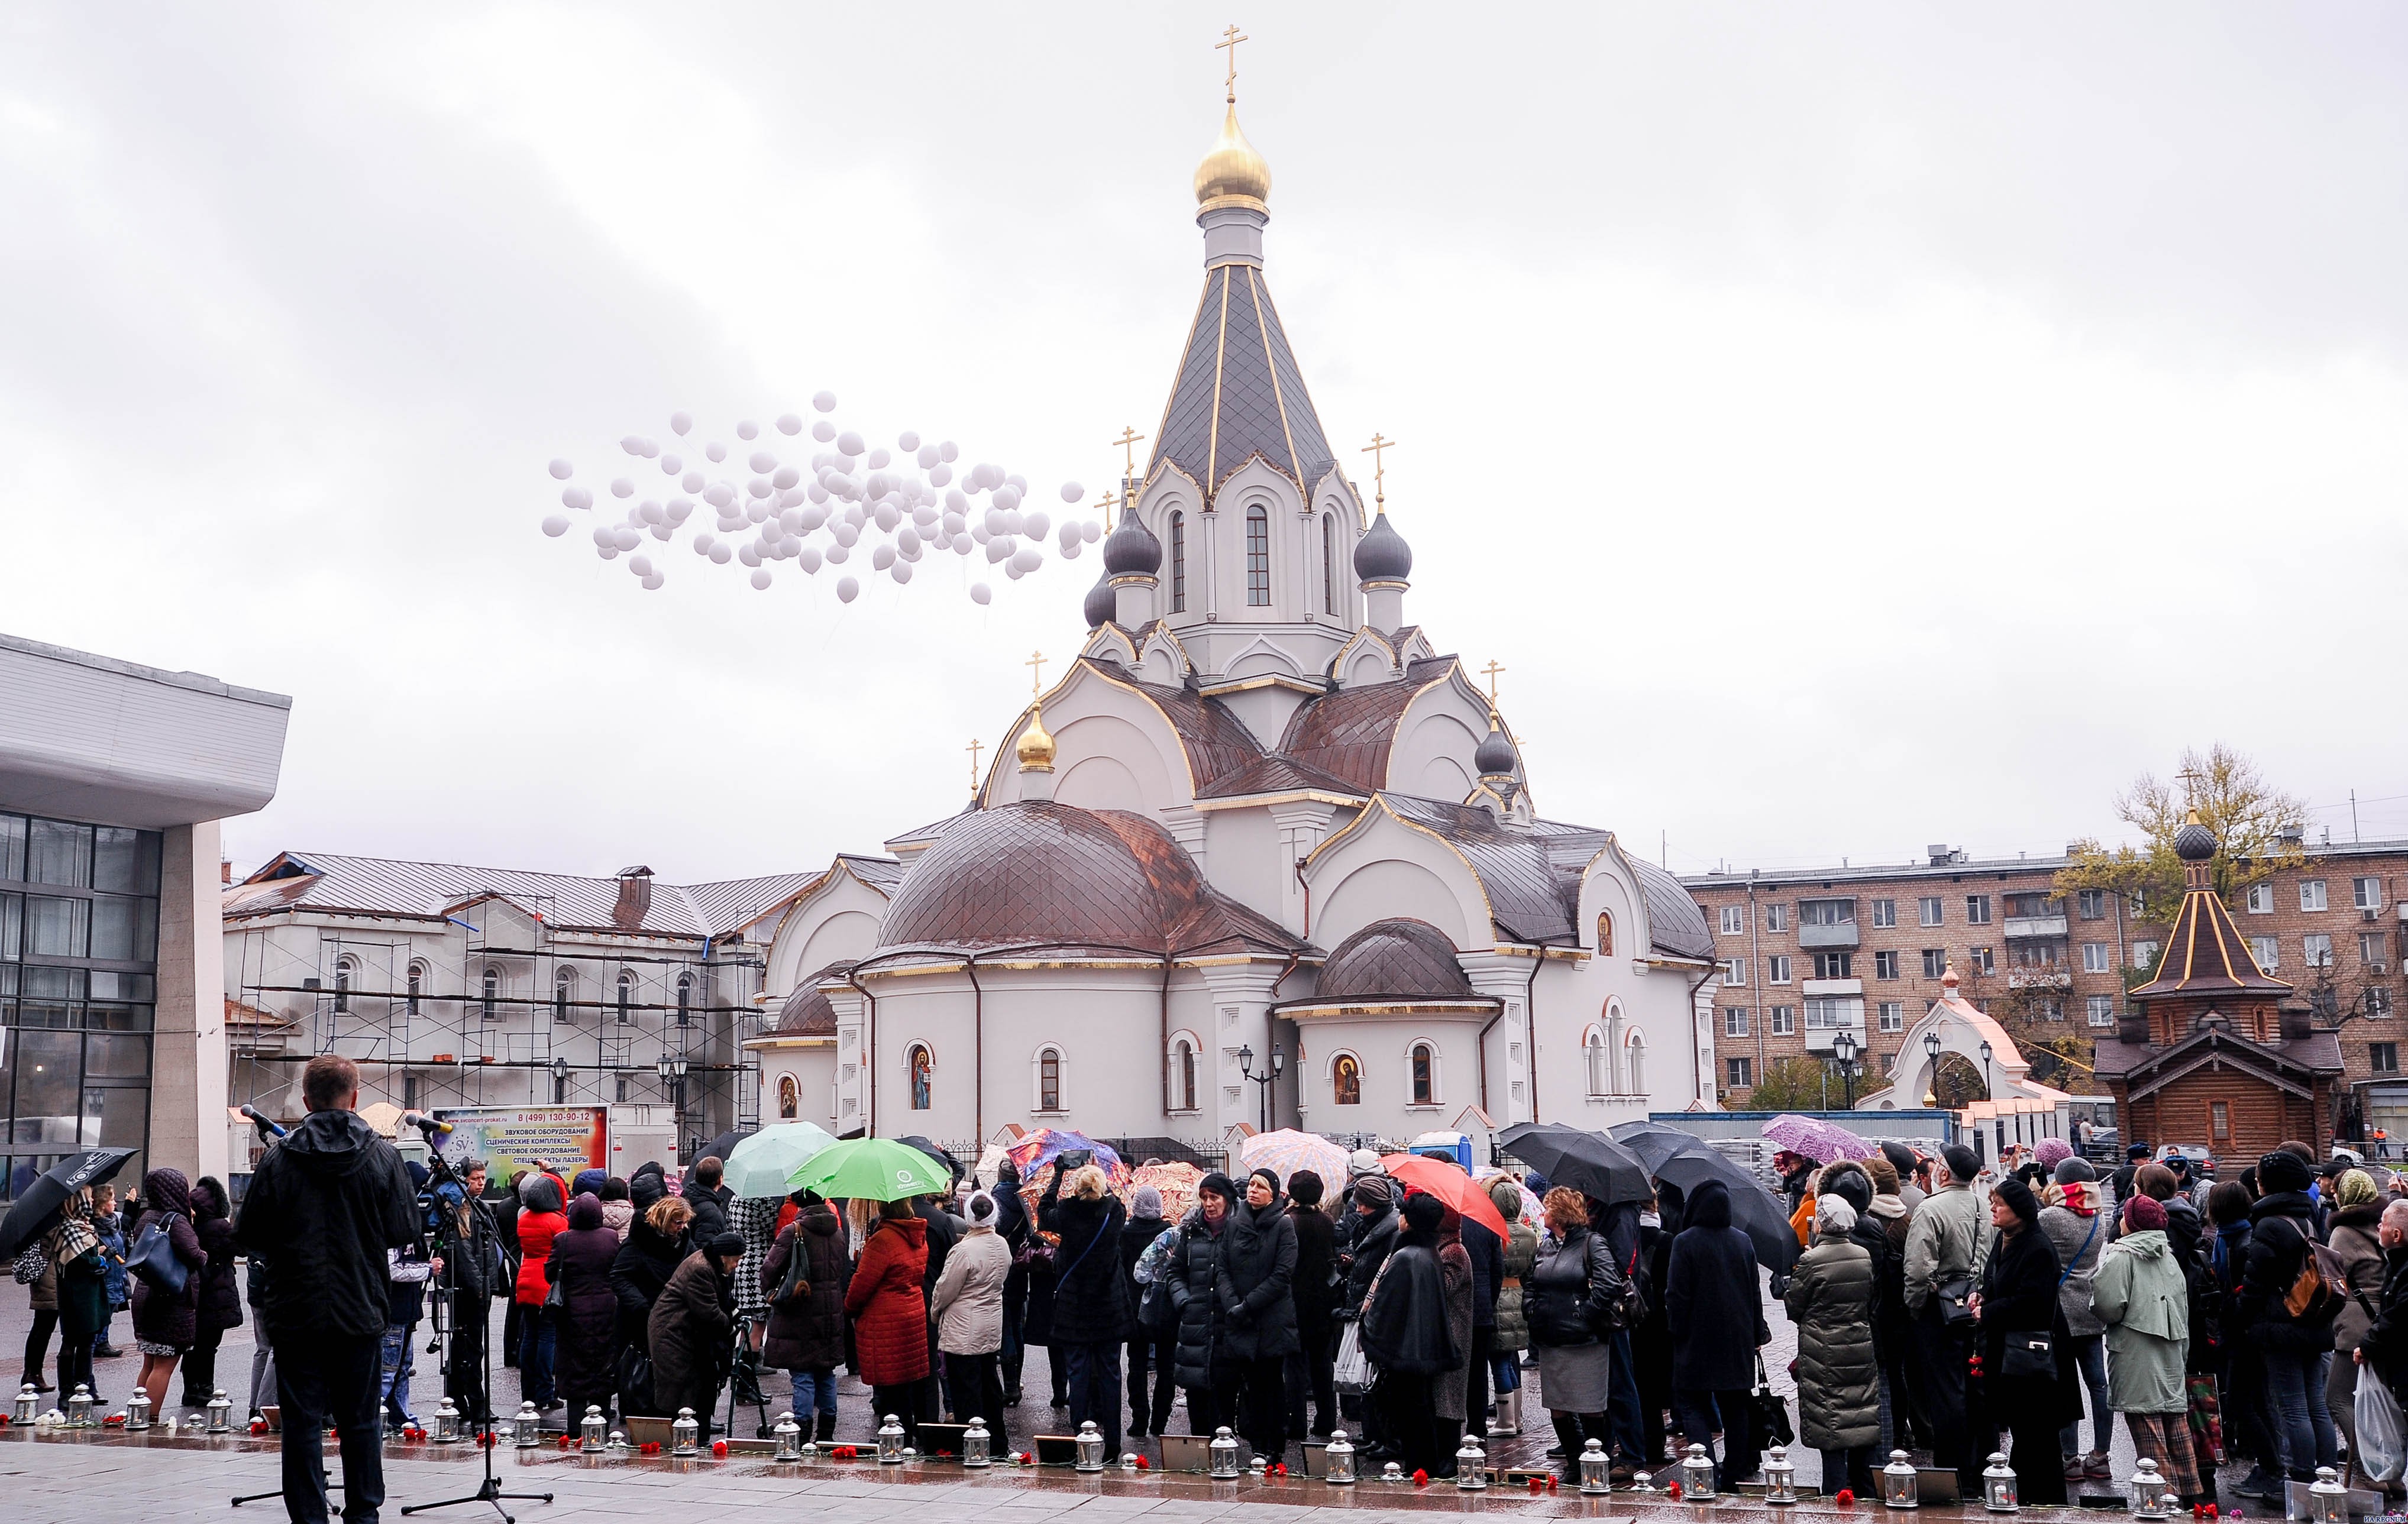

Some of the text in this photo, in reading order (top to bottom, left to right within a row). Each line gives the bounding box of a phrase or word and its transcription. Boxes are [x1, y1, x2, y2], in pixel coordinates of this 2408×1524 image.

[526, 1113, 545, 1122] (499)
[550, 1112, 590, 1121] 130-90-12
[456, 1140, 469, 1151] SV
